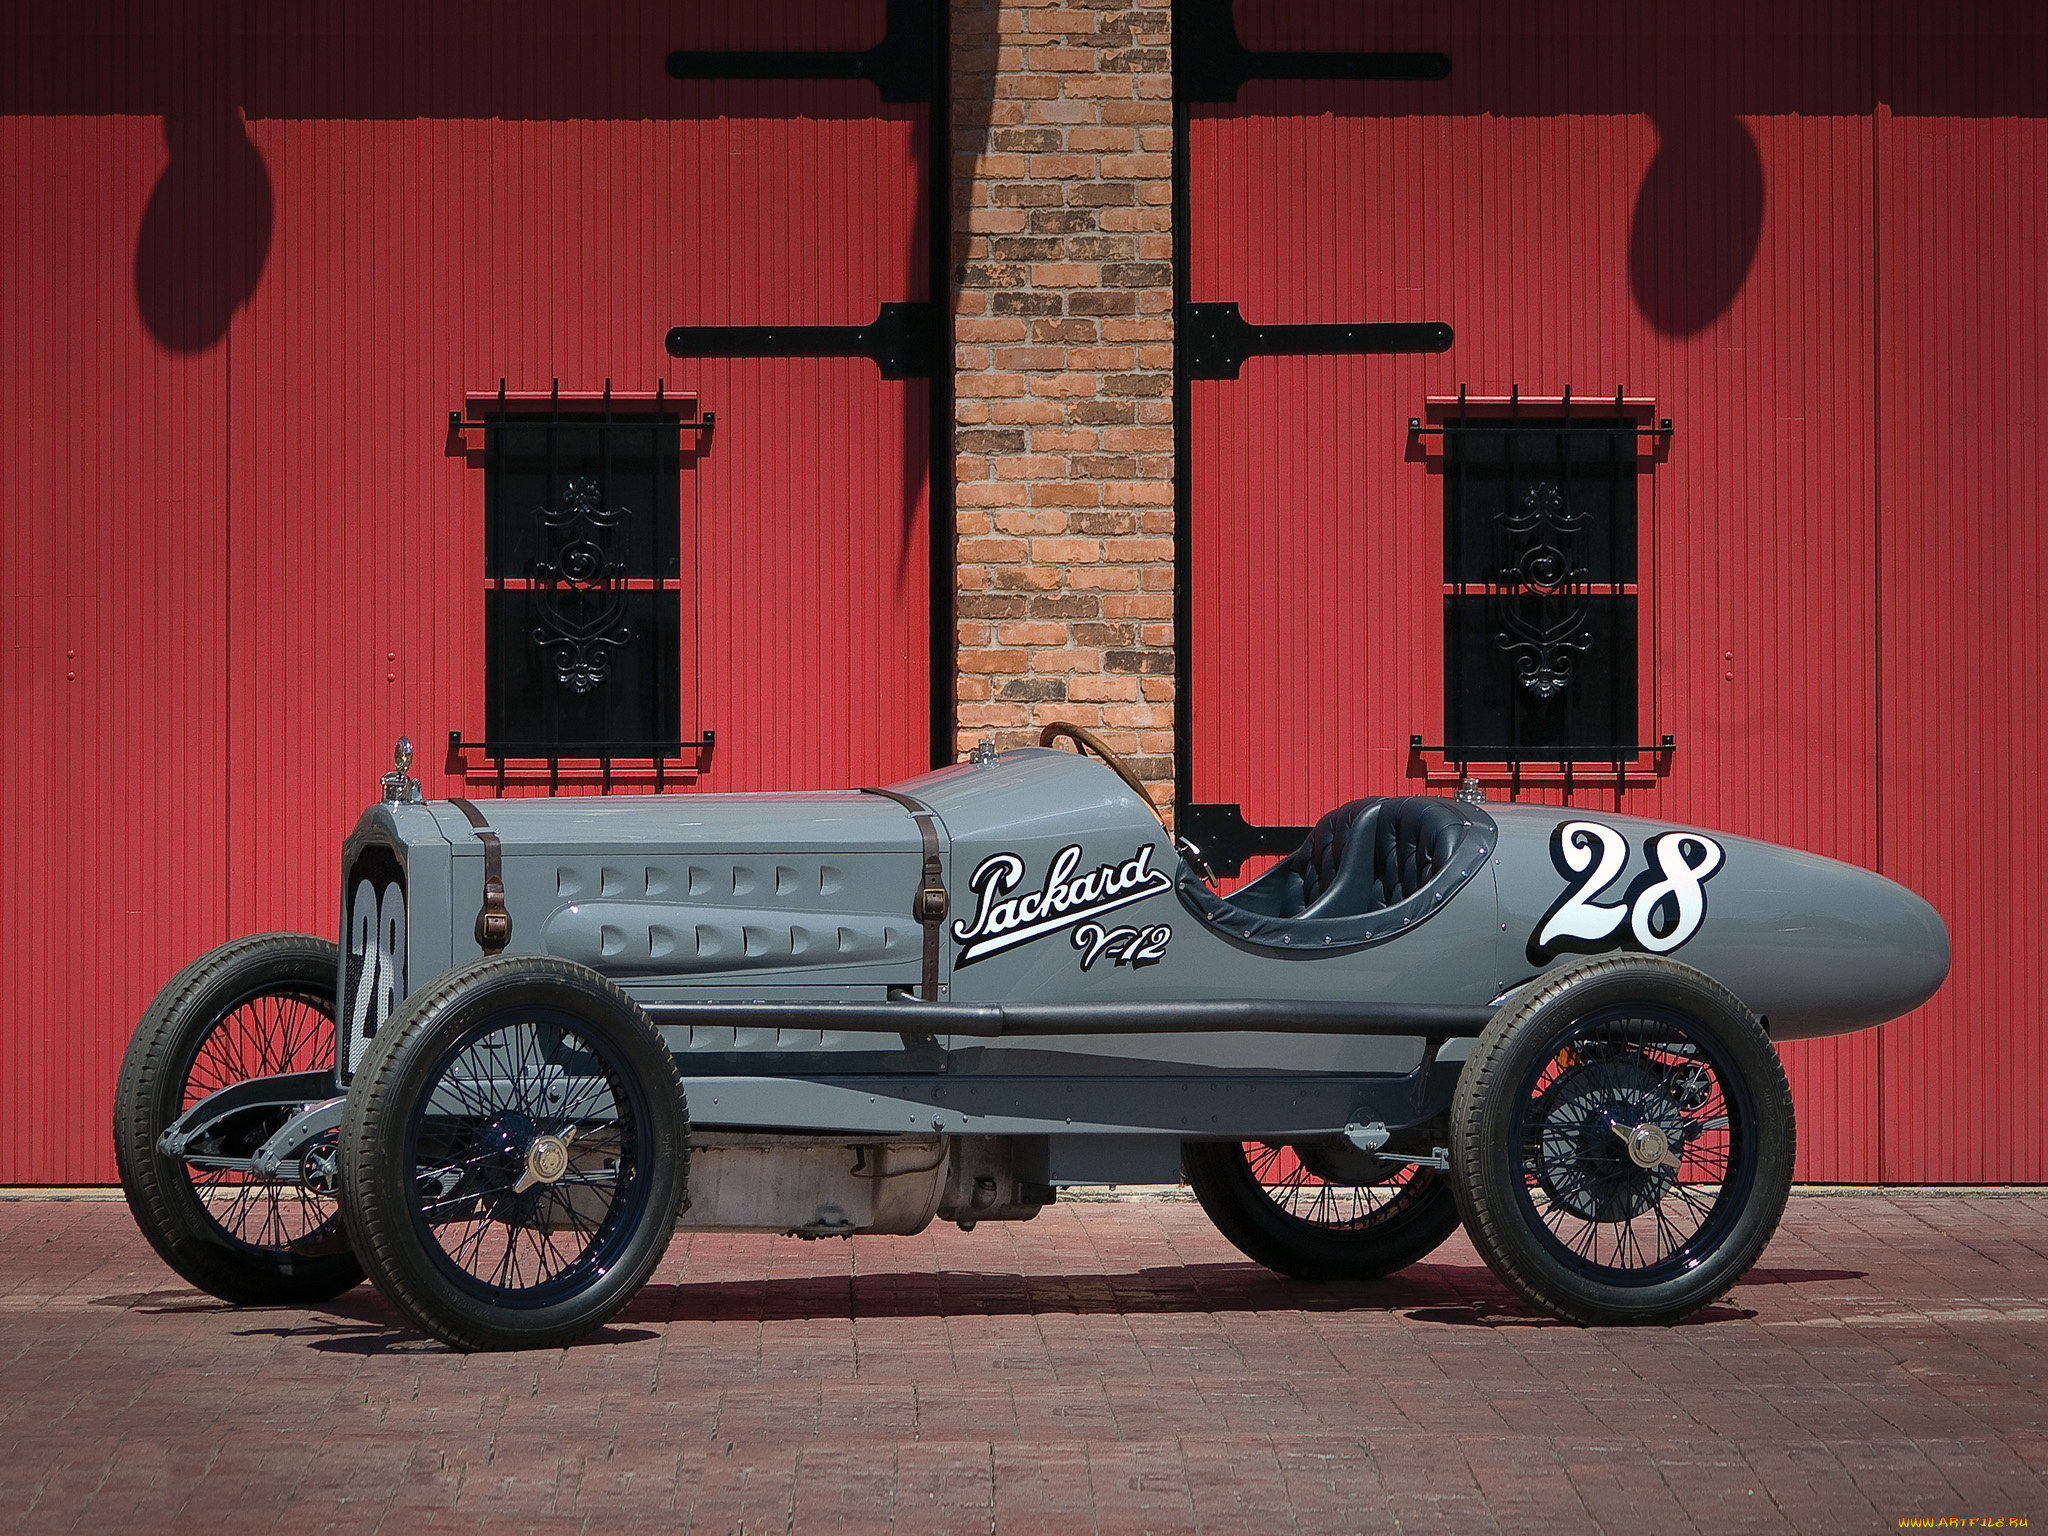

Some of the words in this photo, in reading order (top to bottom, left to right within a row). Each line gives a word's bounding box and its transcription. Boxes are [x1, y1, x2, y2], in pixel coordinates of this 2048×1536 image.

[952, 843, 1173, 966] Packard
[1071, 921, 1172, 972] V-12
[1526, 820, 1725, 966] 28
